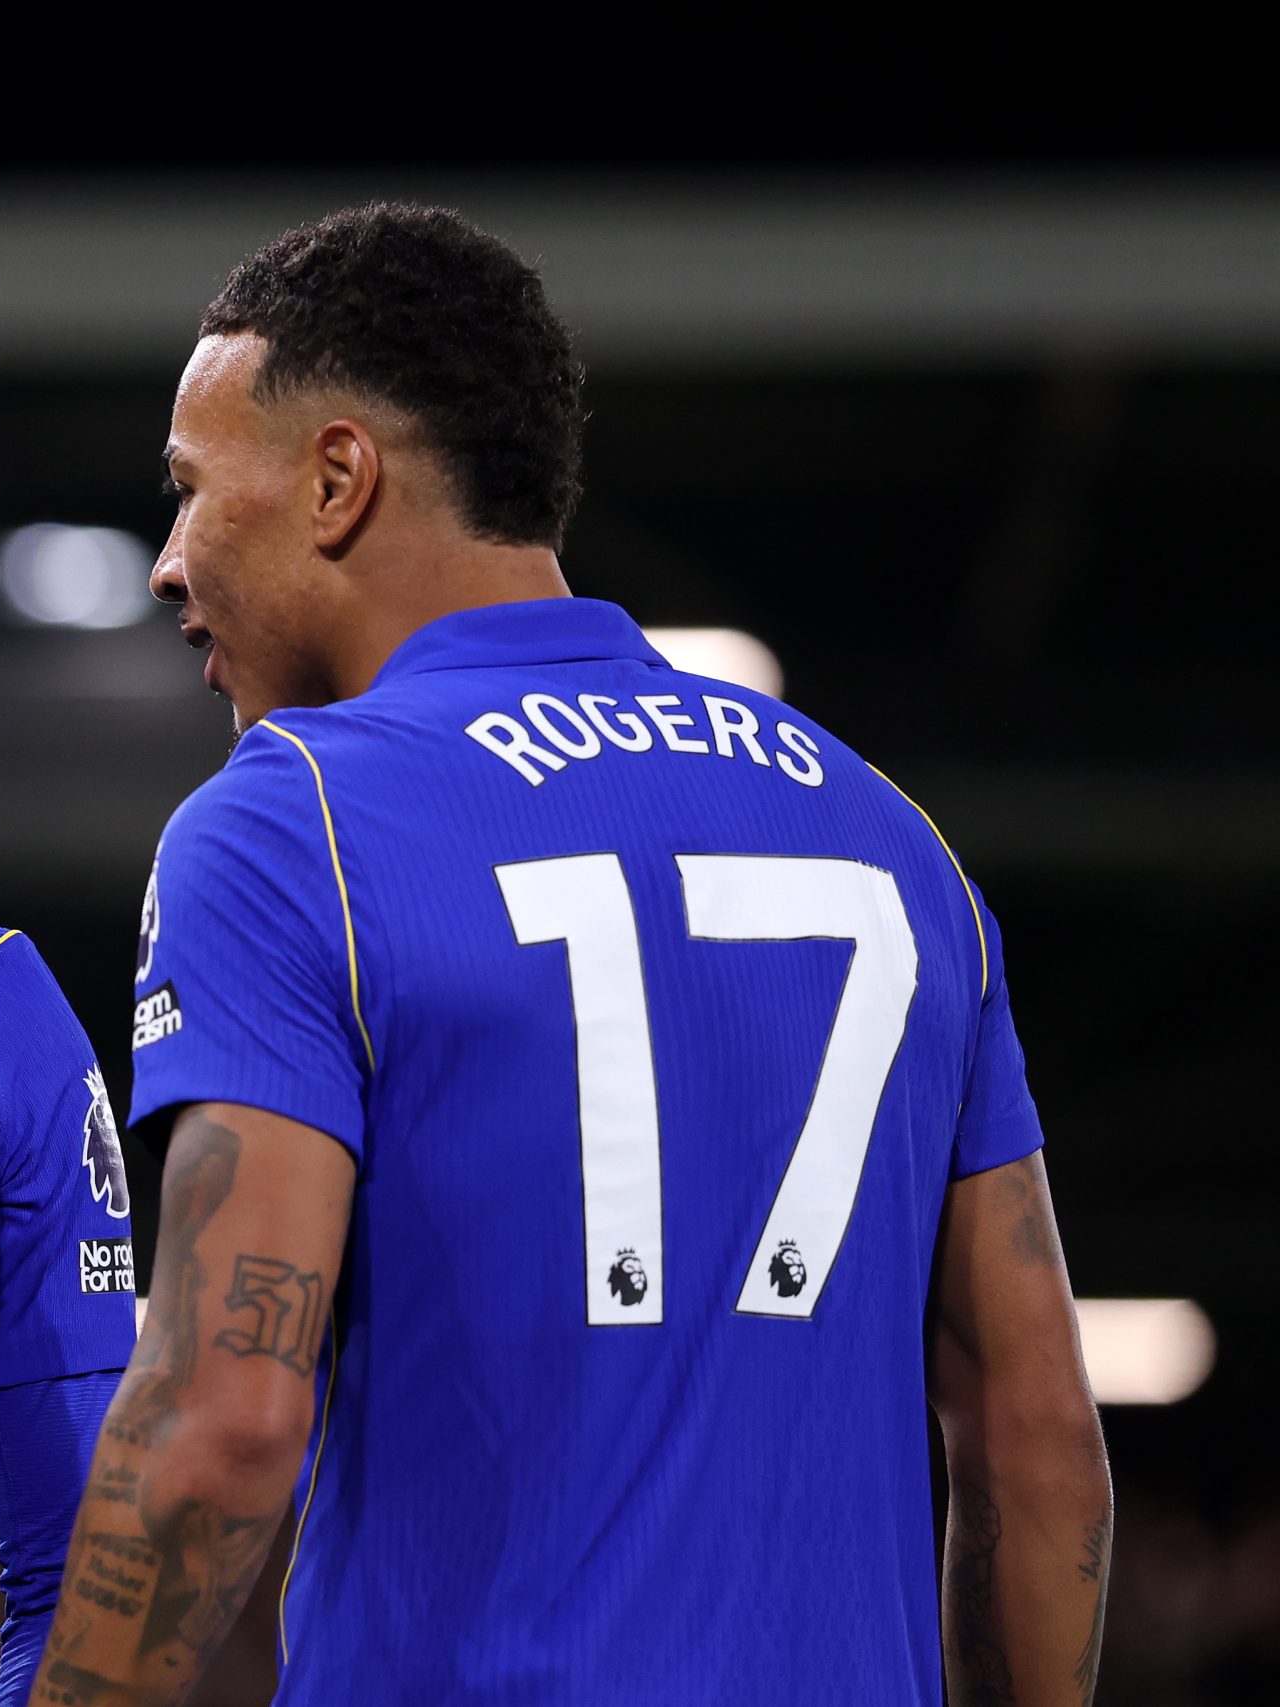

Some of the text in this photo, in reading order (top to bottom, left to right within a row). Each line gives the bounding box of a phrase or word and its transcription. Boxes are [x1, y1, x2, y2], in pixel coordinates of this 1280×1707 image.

[463, 692, 825, 788] ROGERS
[492, 852, 919, 1326] 17
[79, 1240, 112, 1268] No
[212, 1253, 323, 1380] 51
